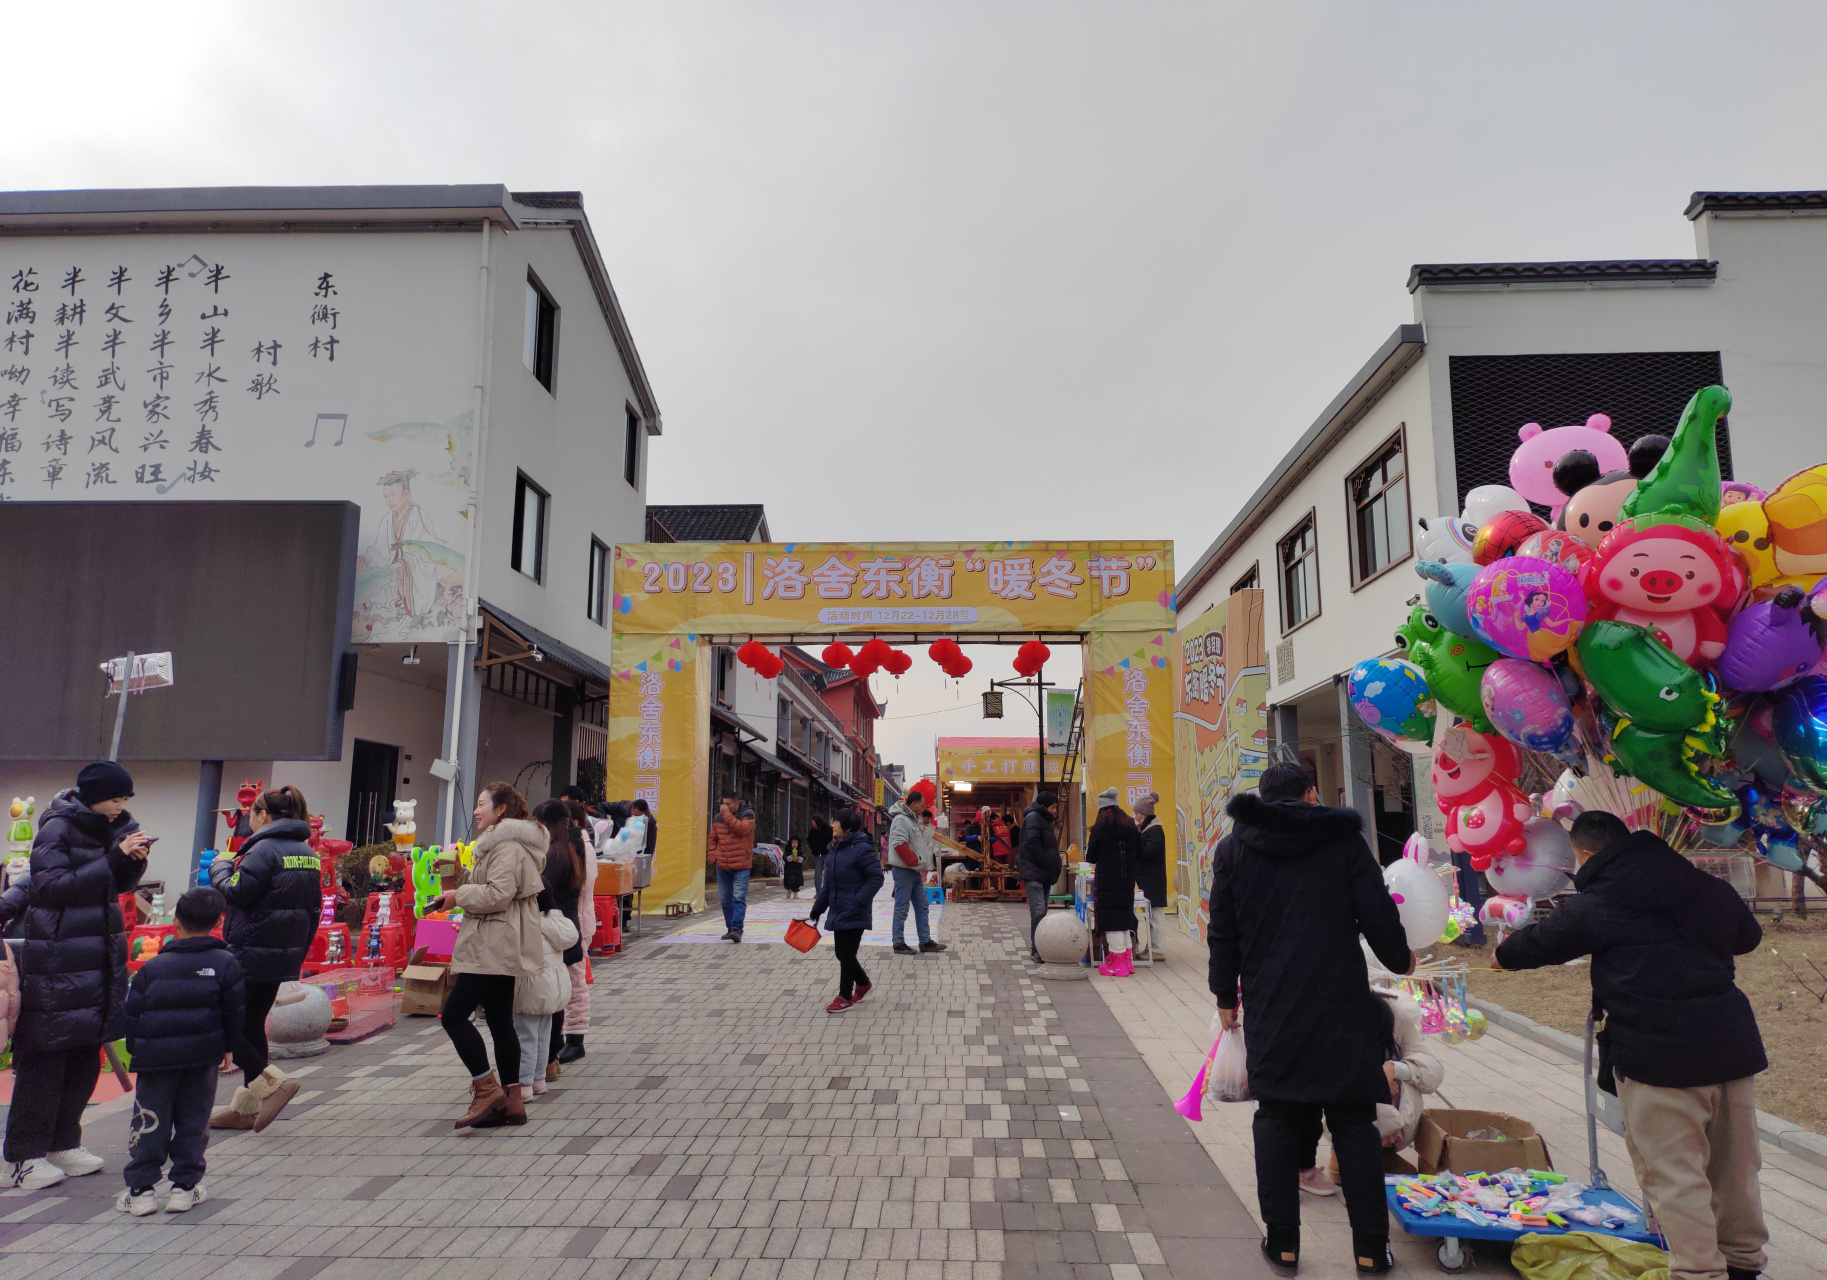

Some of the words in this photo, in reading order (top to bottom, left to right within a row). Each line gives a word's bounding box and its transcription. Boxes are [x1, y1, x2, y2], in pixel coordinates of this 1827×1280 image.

[134, 264, 180, 485] 半乡半市家兴旺
[247, 339, 283, 401] 村歌
[307, 271, 341, 362] 东衡村
[0, 266, 39, 501] 花满村呦幸福东
[641, 561, 738, 594] 2023
[1185, 635, 1204, 666] 2023
[633, 671, 665, 877] 洛舍东衡『暖
[1123, 668, 1153, 832] 洛舍东衡『暖
